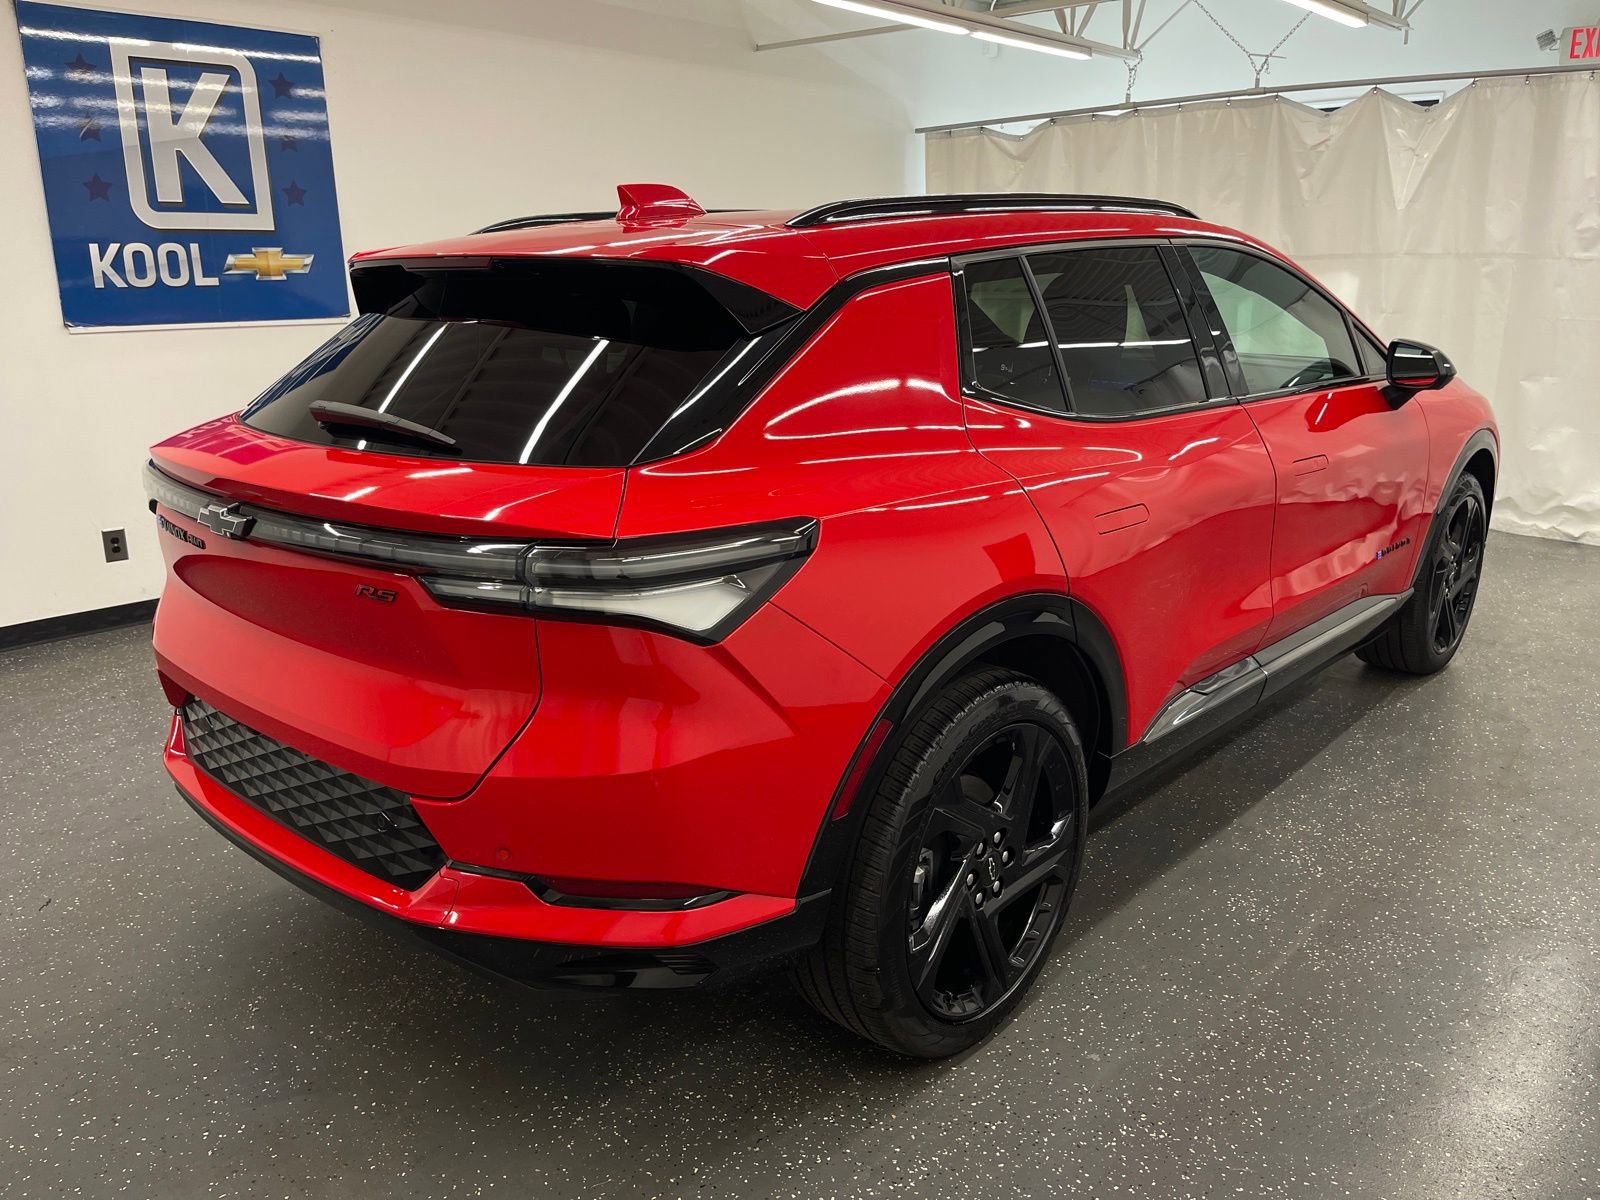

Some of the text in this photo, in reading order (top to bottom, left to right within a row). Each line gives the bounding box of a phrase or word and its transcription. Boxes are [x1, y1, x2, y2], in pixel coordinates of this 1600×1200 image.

[1569, 27, 1600, 60] EXI
[140, 67, 250, 205] K
[88, 242, 220, 289] KOOL
[353, 584, 398, 603] RS
